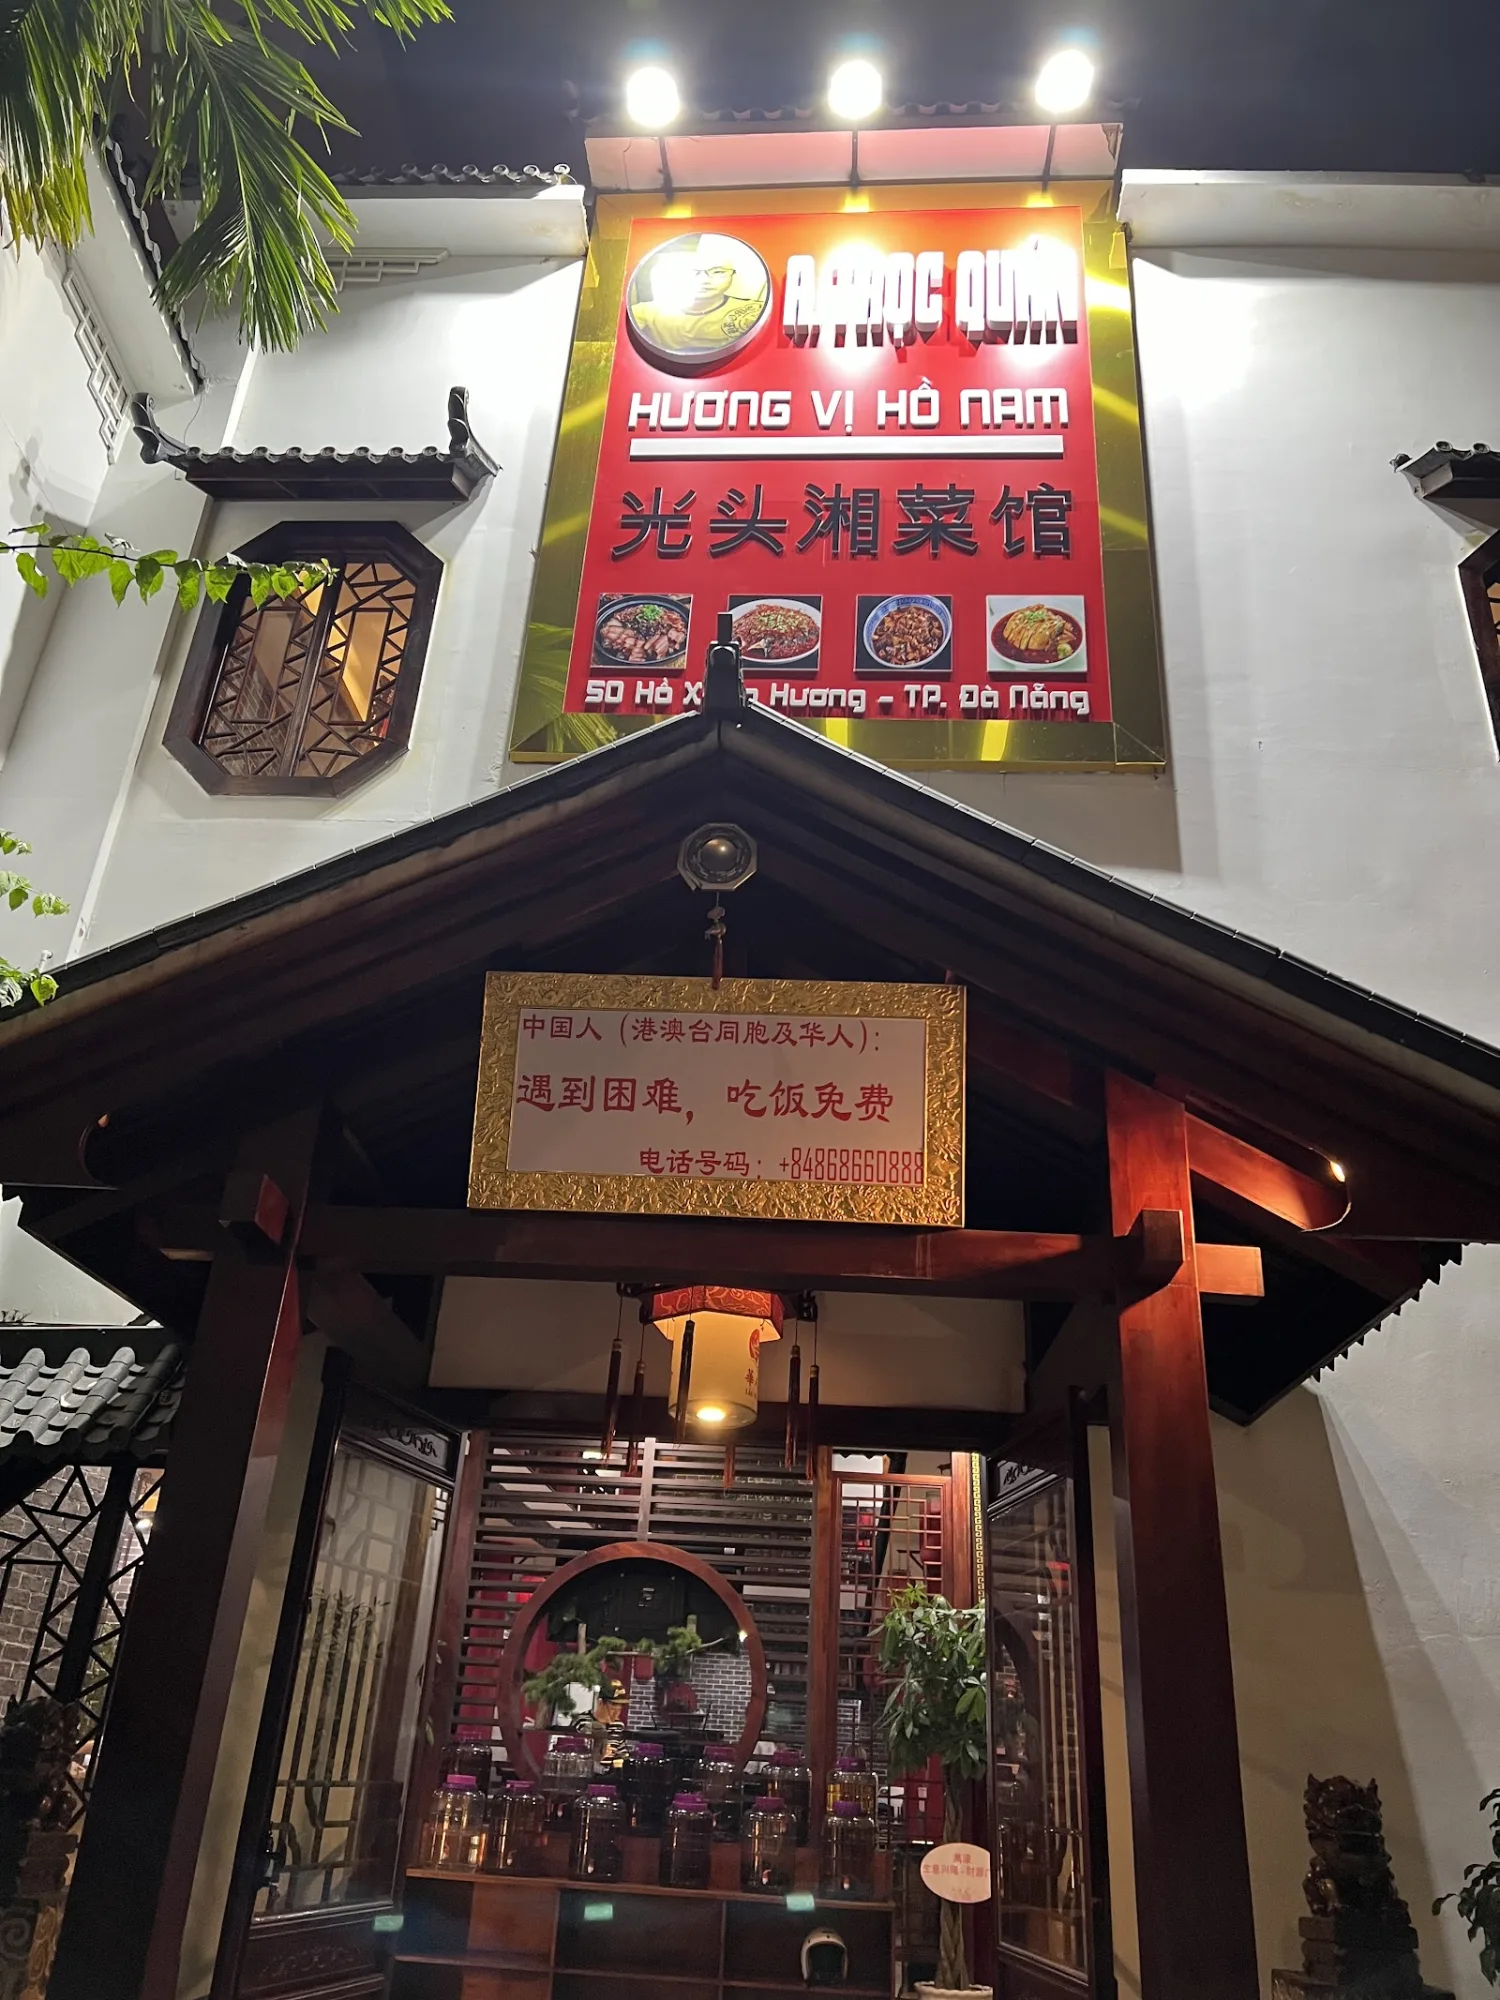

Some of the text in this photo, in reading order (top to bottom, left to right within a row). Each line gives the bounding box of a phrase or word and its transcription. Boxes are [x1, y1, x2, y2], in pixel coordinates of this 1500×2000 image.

[628, 375, 1069, 436] HƯƠNG VỊ HỒ NAM
[612, 481, 1073, 559] 光头湘菜馆
[584, 679, 625, 704] 50
[634, 676, 674, 705] Hồ
[769, 682, 867, 713] Hương
[903, 684, 948, 709] TP.
[959, 684, 999, 709] Đà
[779, 1147, 924, 1185] +84868660888
